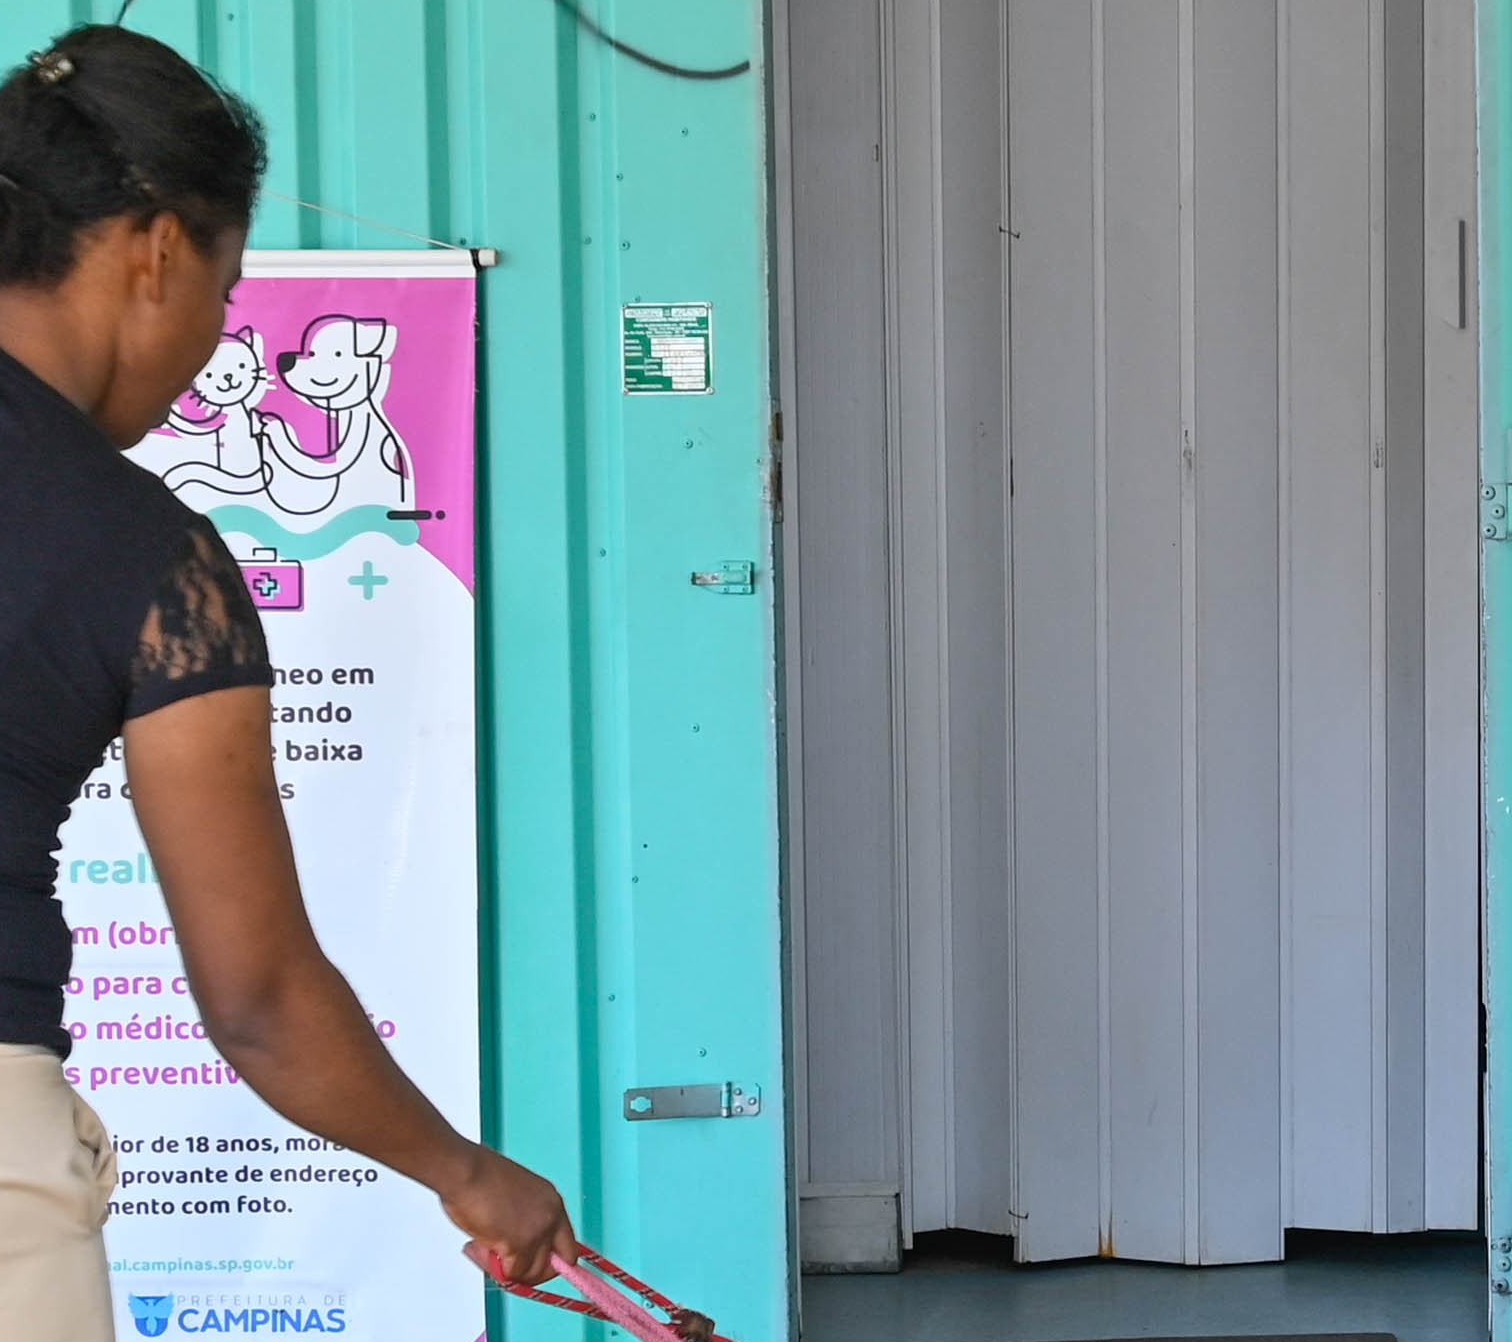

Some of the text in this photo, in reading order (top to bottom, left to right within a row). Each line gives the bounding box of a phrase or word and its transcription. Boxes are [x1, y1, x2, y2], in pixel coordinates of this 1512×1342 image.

[332, 668, 374, 684] em
[286, 738, 362, 761] baixa
[93, 976, 162, 1000] para
[151, 1136, 179, 1153] de
[186, 1137, 209, 1153] 18
[216, 1137, 279, 1154] anos,
[235, 1165, 263, 1182] de
[270, 1165, 378, 1187] endereço
[182, 1200, 230, 1215] com
[237, 1195, 293, 1214] foto.
[178, 1294, 346, 1306] PREFEITURA DE
[178, 1309, 346, 1333] CAMPINAS
